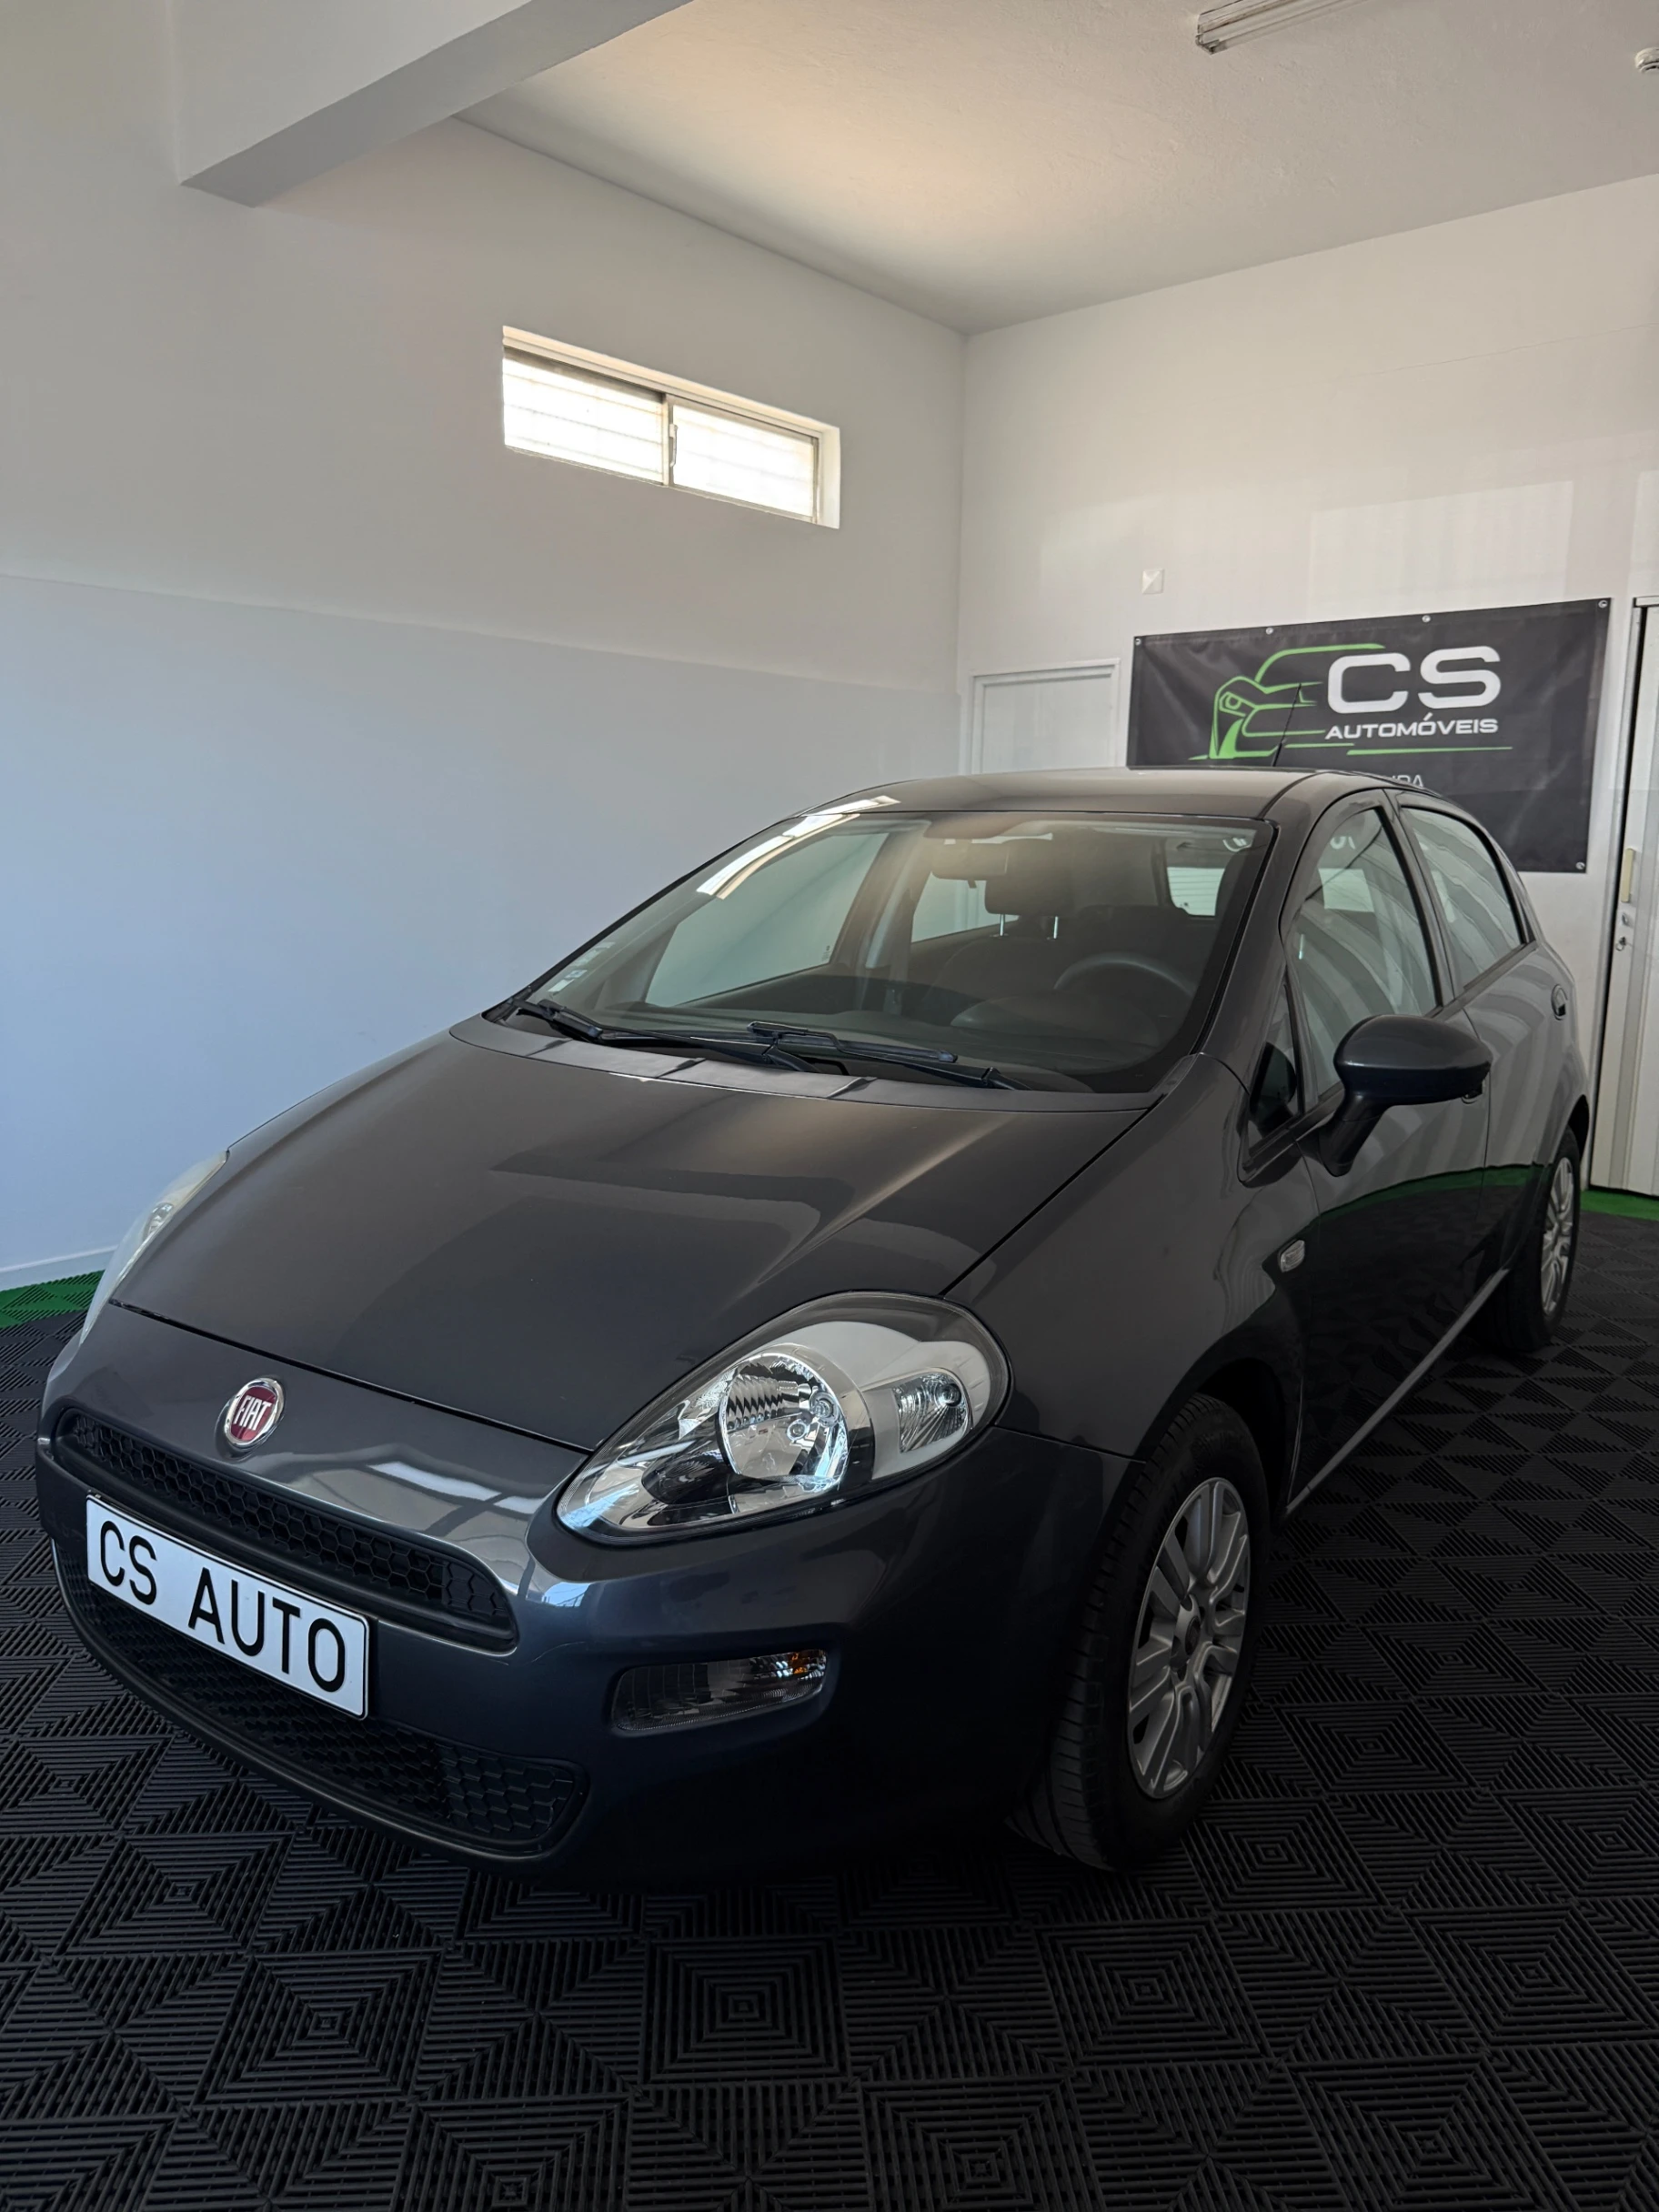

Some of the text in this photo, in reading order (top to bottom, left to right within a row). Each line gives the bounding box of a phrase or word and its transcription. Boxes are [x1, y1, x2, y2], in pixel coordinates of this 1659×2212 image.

[1327, 646, 1502, 714] CS
[1324, 712, 1499, 740] AUTOMÓVEIS
[233, 1394, 273, 1431] FIAT
[99, 1520, 346, 1693] CS AUTO
